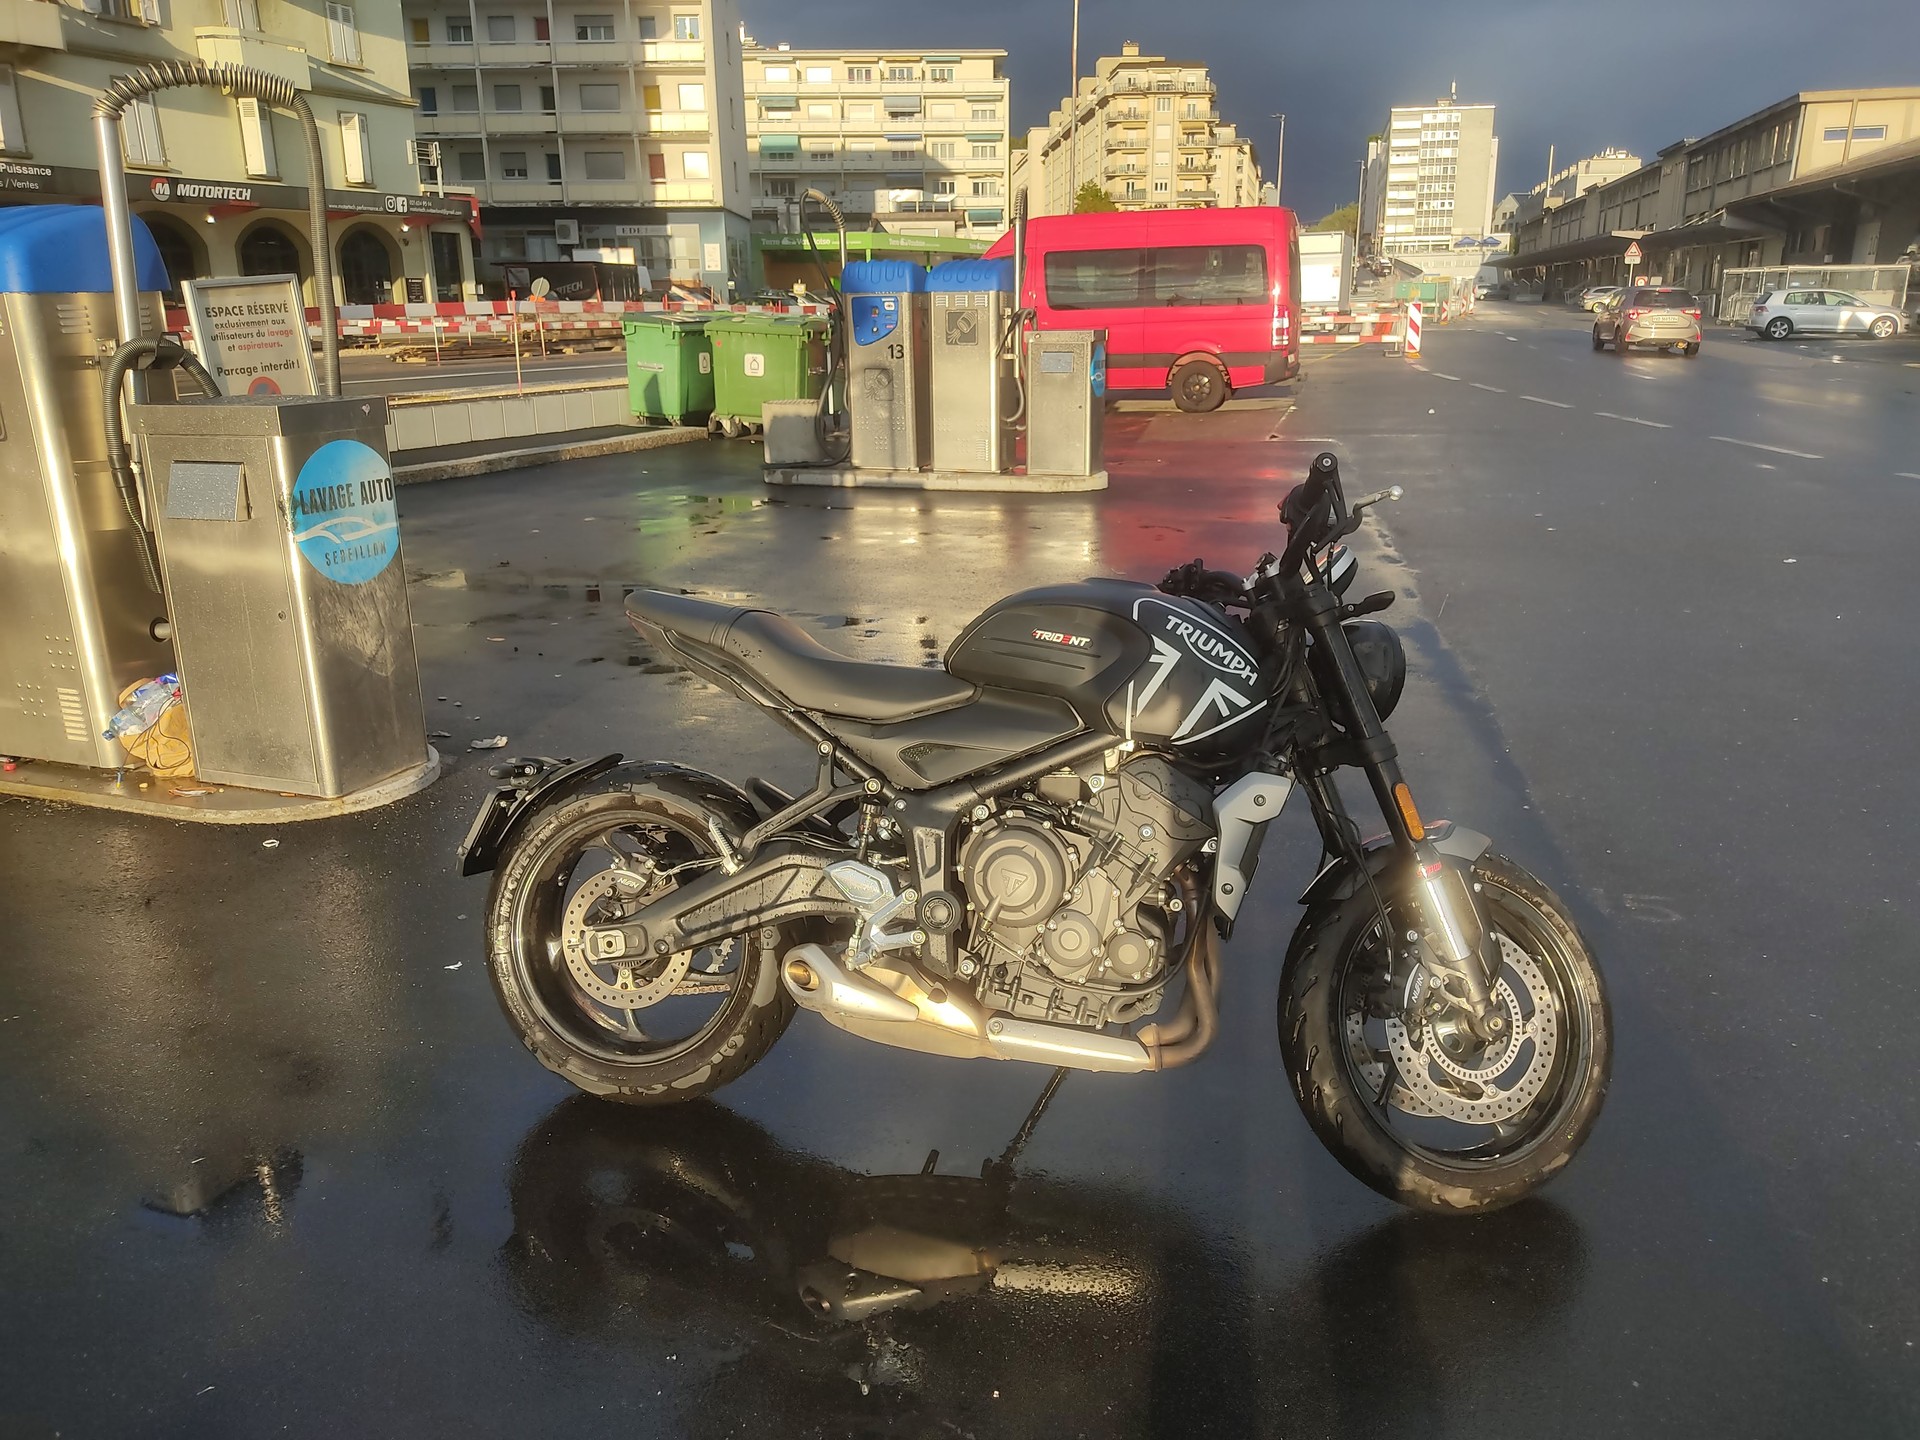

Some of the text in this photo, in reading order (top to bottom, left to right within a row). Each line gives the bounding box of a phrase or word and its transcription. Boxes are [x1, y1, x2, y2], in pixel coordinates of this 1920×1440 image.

[0, 162, 52, 176] Puissance
[11, 179, 39, 190] Ventes
[177, 183, 251, 200] MOTORTECH
[205, 300, 289, 318] ESPACE RÉSERVÉ
[214, 319, 269, 330] exclusivement
[211, 328, 294, 342] utilisateurs du lavage
[227, 341, 283, 352] et aspirateurs.
[887, 344, 904, 359] 13
[217, 365, 258, 377] Parcage
[299, 477, 394, 516] LAVAGE AUTO
[1034, 630, 1090, 647] TRIDENT
[1165, 615, 1258, 687] TRIUMPH
